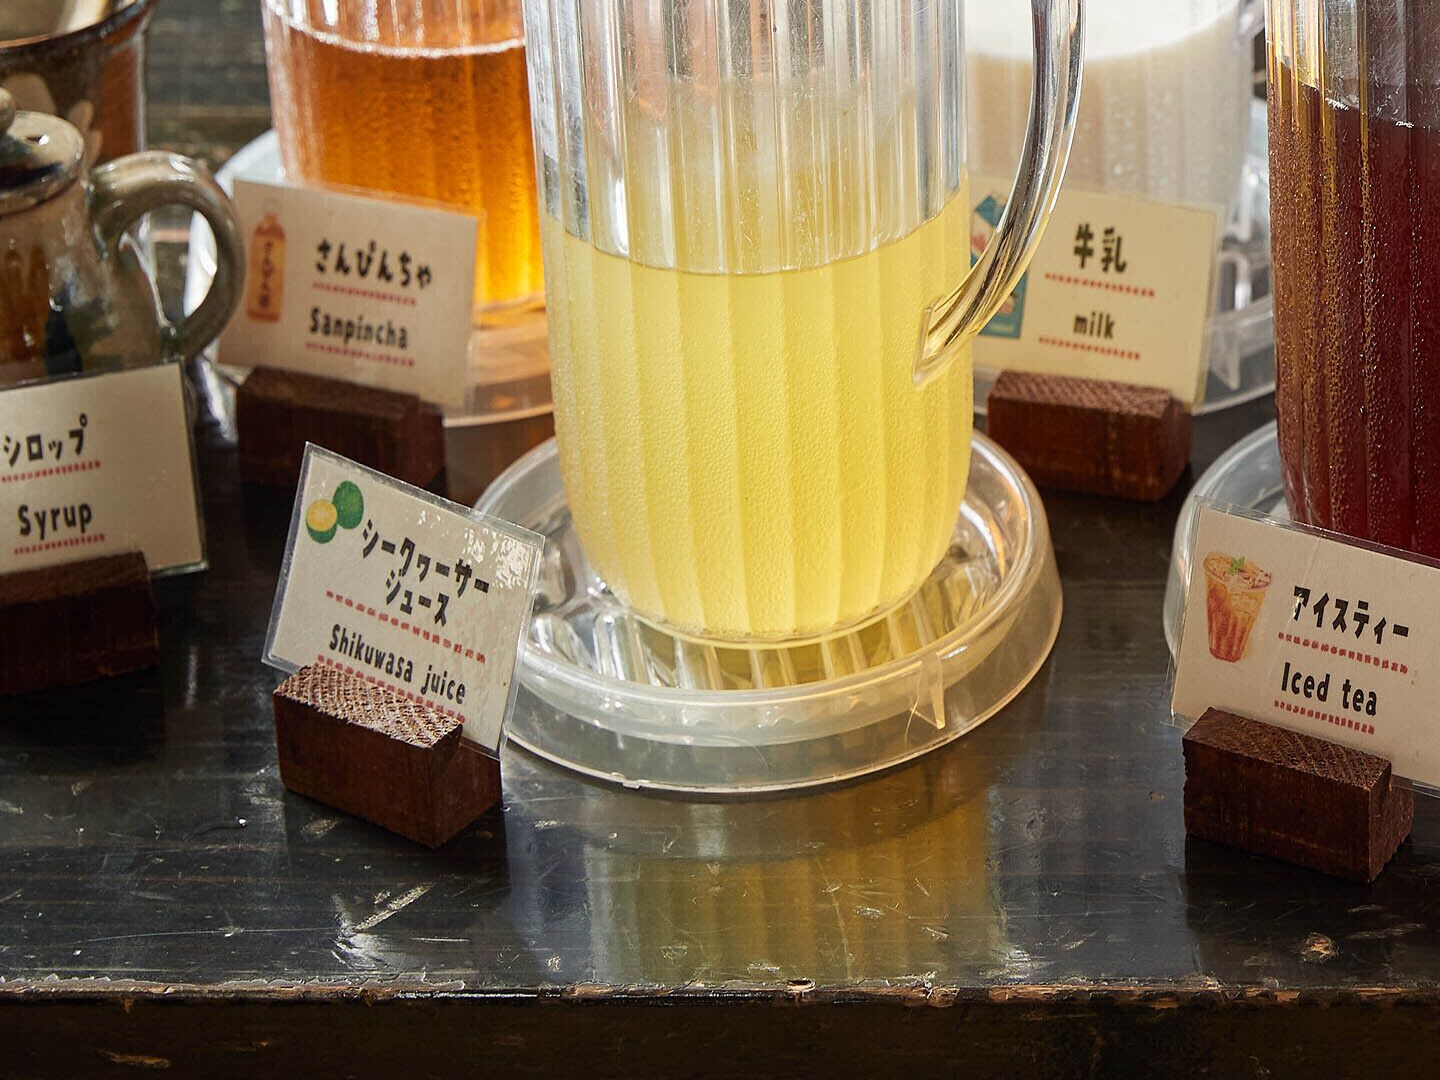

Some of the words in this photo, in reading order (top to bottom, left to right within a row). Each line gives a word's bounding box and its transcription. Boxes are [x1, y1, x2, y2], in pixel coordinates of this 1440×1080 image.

[315, 238, 432, 288] さんぴんちゃ
[1073, 223, 1127, 273] 牛乳
[309, 307, 408, 349] Sanpincha
[1073, 311, 1116, 339] milk
[3, 412, 88, 467] シロップ
[17, 503, 92, 541] Syrup
[385, 568, 450, 627] ジュース
[1293, 586, 1409, 645] アイスティー
[329, 624, 413, 683] Shikuwasa
[420, 664, 465, 705] juice
[1281, 661, 1330, 702] Iced
[1342, 678, 1377, 717] tea
